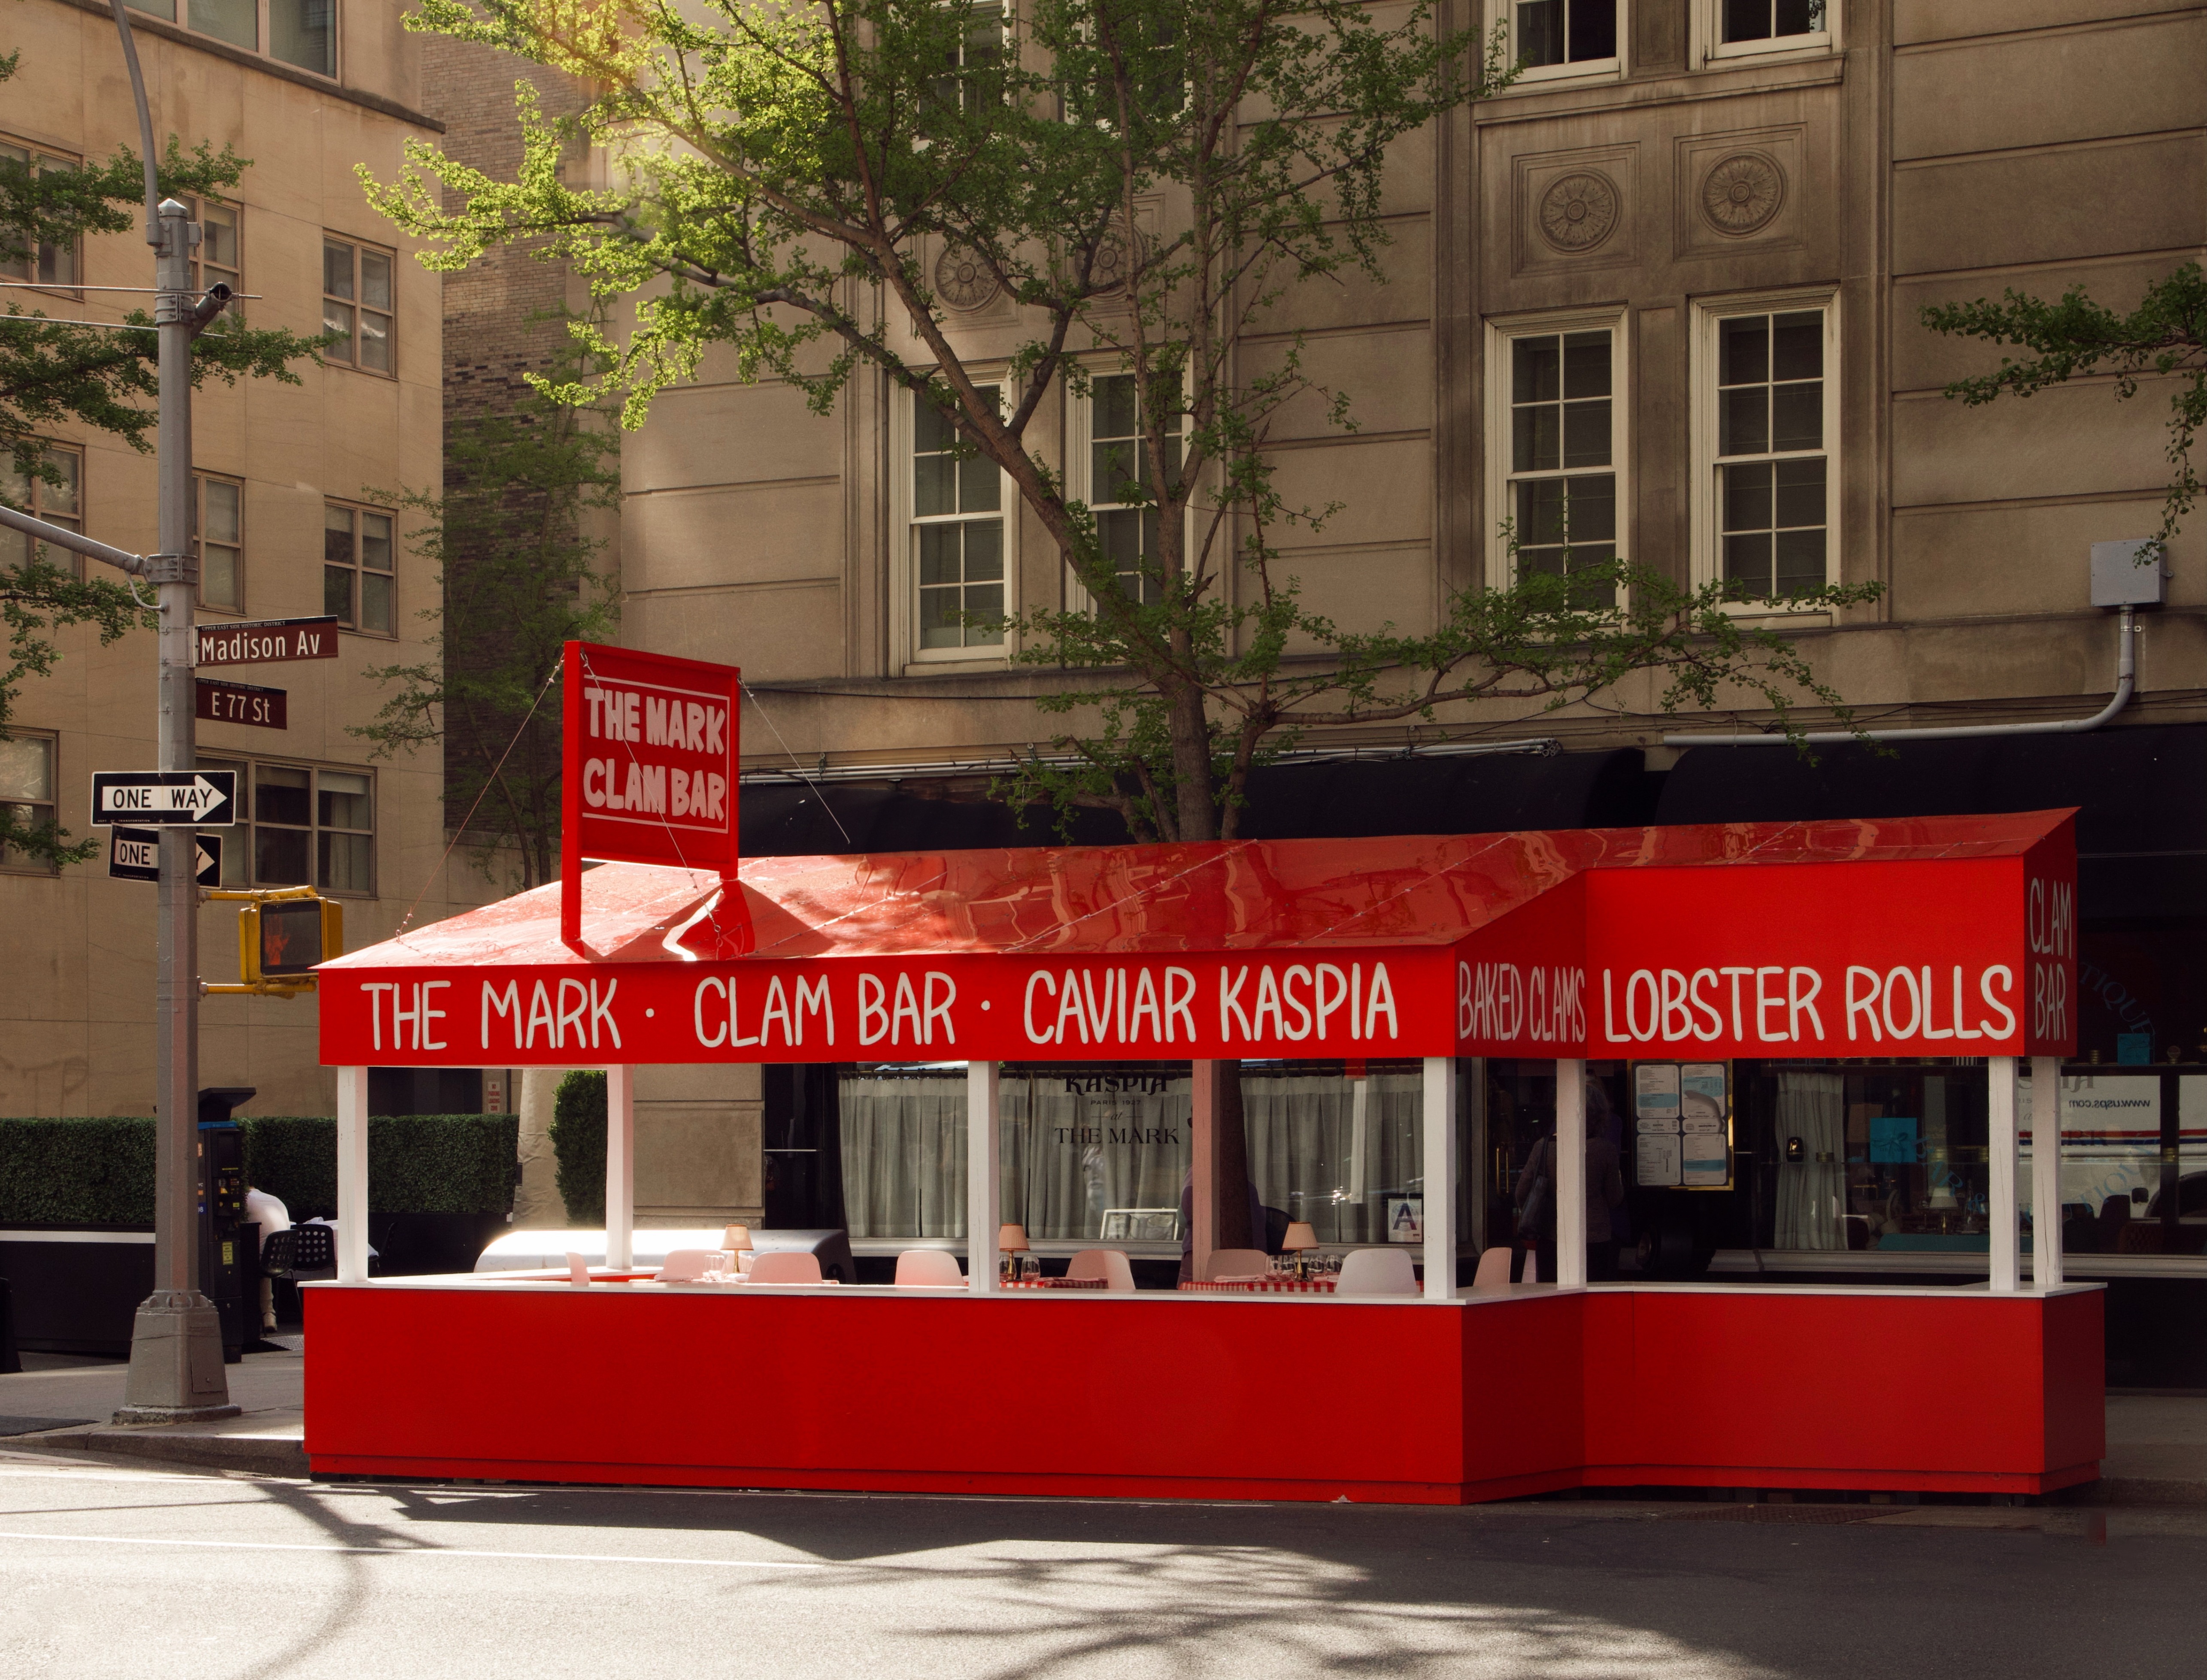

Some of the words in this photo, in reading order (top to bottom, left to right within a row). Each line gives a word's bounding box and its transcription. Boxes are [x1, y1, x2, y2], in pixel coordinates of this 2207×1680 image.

[202, 632, 285, 661] Madison
[297, 631, 320, 655] Av
[212, 691, 220, 716] E
[227, 694, 246, 719] 77
[253, 697, 270, 723] St
[584, 687, 640, 743] THE
[646, 696, 725, 755] MARK
[113, 789, 151, 808] ONE
[172, 789, 213, 808] WAY
[583, 757, 666, 814] CLAM
[671, 768, 726, 822] BAR
[120, 843, 150, 865] ONE
[2030, 878, 2071, 958] CLAM
[360, 981, 451, 1050] THE
[481, 978, 621, 1049] MARK
[694, 974, 834, 1048] CLAM
[858, 971, 956, 1045] BAR
[1024, 966, 1196, 1044] CAVIAR
[1220, 962, 1398, 1042] KASPIA
[1459, 961, 1523, 1041] BAKED
[1529, 966, 1586, 1043] CLAMS
[1603, 966, 1825, 1042] LOBSTER
[1846, 964, 2016, 1042] ROLLS
[2035, 963, 2067, 1040] BAR
[1064, 1074, 1168, 1096] KASPIA
[1111, 1112, 1122, 1120] at
[1055, 1128, 1101, 1144] THE
[1109, 1128, 1179, 1144] MARK
[1393, 1203, 1417, 1230] A
